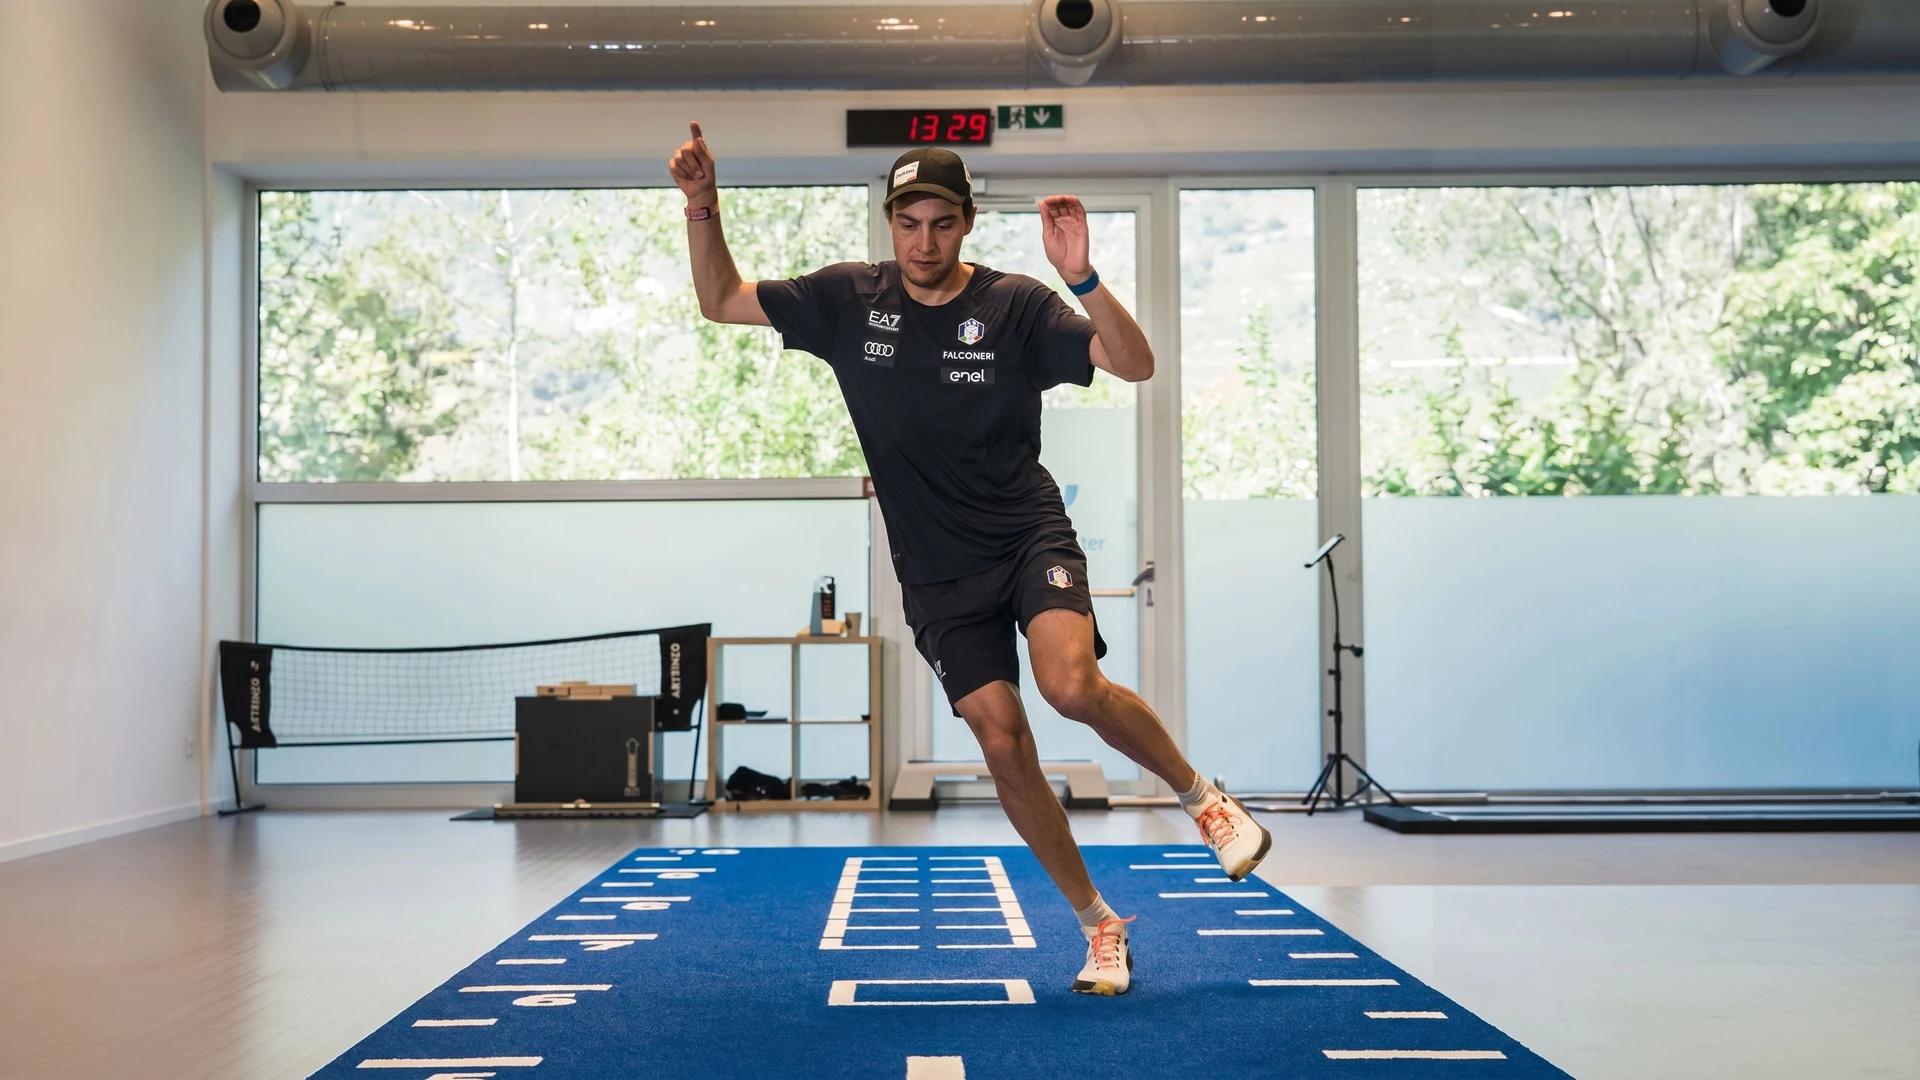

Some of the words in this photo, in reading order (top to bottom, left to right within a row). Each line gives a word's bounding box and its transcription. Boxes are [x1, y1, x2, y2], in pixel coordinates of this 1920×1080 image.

[909, 114, 939, 141] 13
[946, 113, 987, 141] 29
[869, 310, 901, 327] EA7
[942, 351, 995, 360] FALCONERI
[950, 369, 985, 382] enel
[512, 993, 577, 1007] 6
